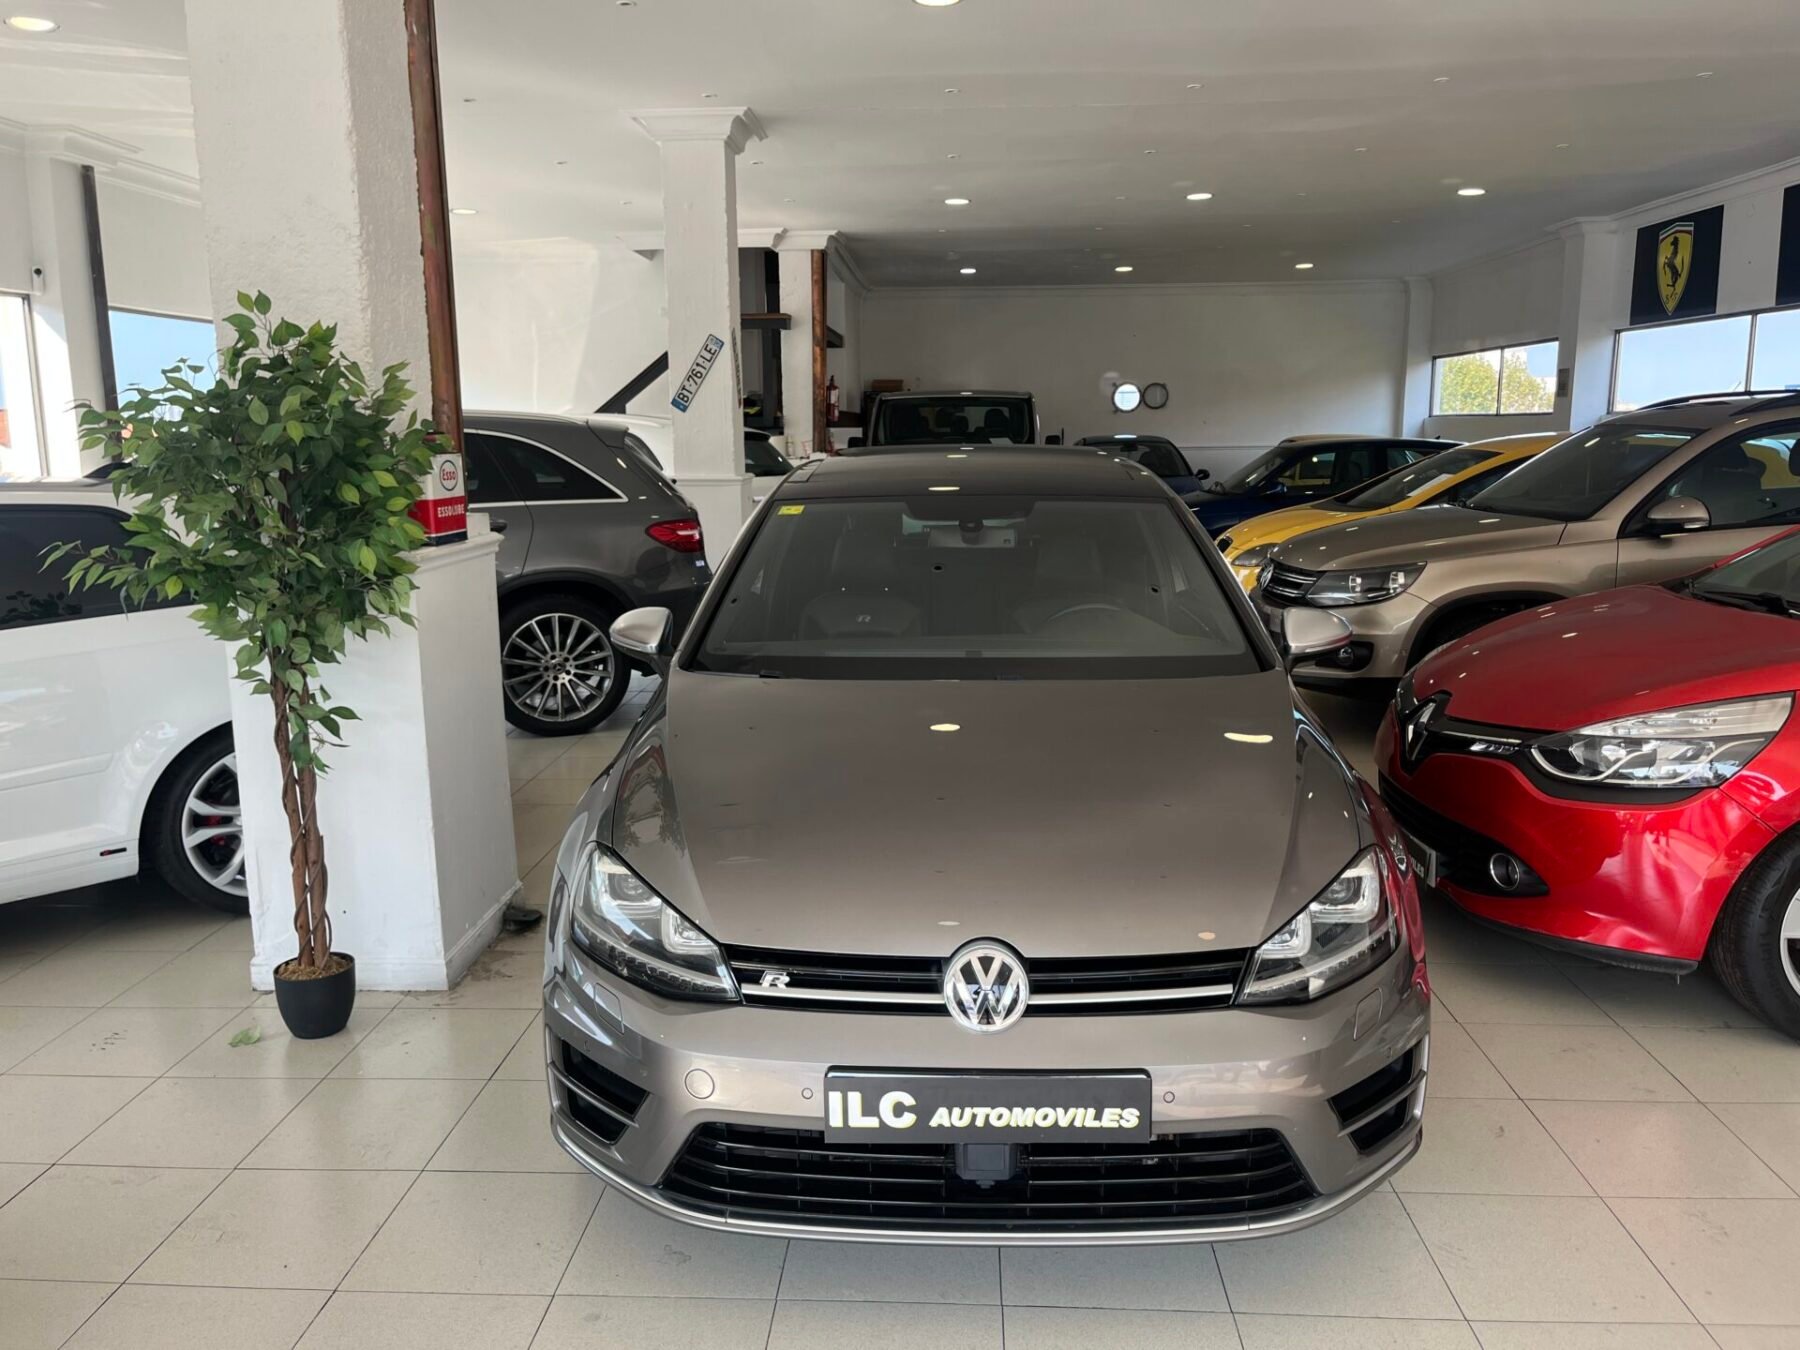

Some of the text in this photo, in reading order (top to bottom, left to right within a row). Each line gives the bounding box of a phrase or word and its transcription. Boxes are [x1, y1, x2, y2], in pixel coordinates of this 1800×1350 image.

[442, 469, 456, 481] Esso
[760, 970, 791, 989] R
[948, 948, 1026, 1030] VW
[827, 1091, 1141, 1129] ILC AUTOMOVILES
